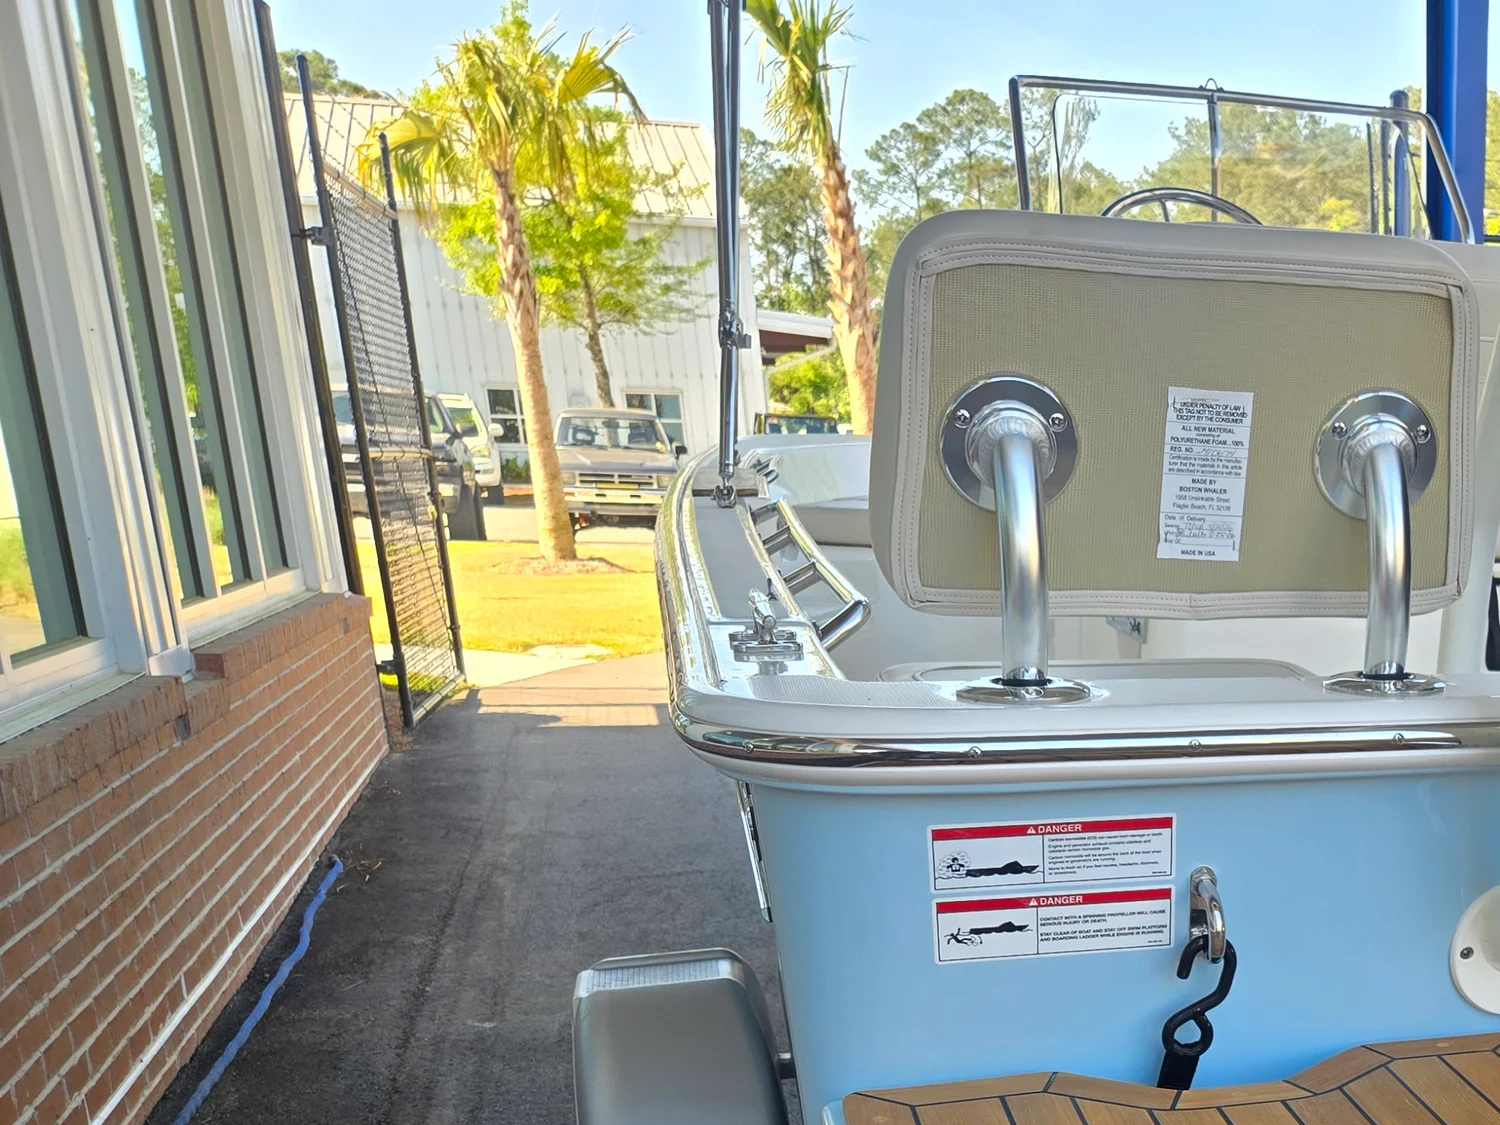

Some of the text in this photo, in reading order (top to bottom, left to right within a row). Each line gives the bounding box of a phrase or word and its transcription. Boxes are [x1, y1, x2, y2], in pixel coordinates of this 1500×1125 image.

[1171, 436, 1211, 444] POLYURETHANE
[1172, 502, 1189, 510] Flagler
[1038, 824, 1082, 834] DANGER
[1040, 895, 1083, 905] DANGER
